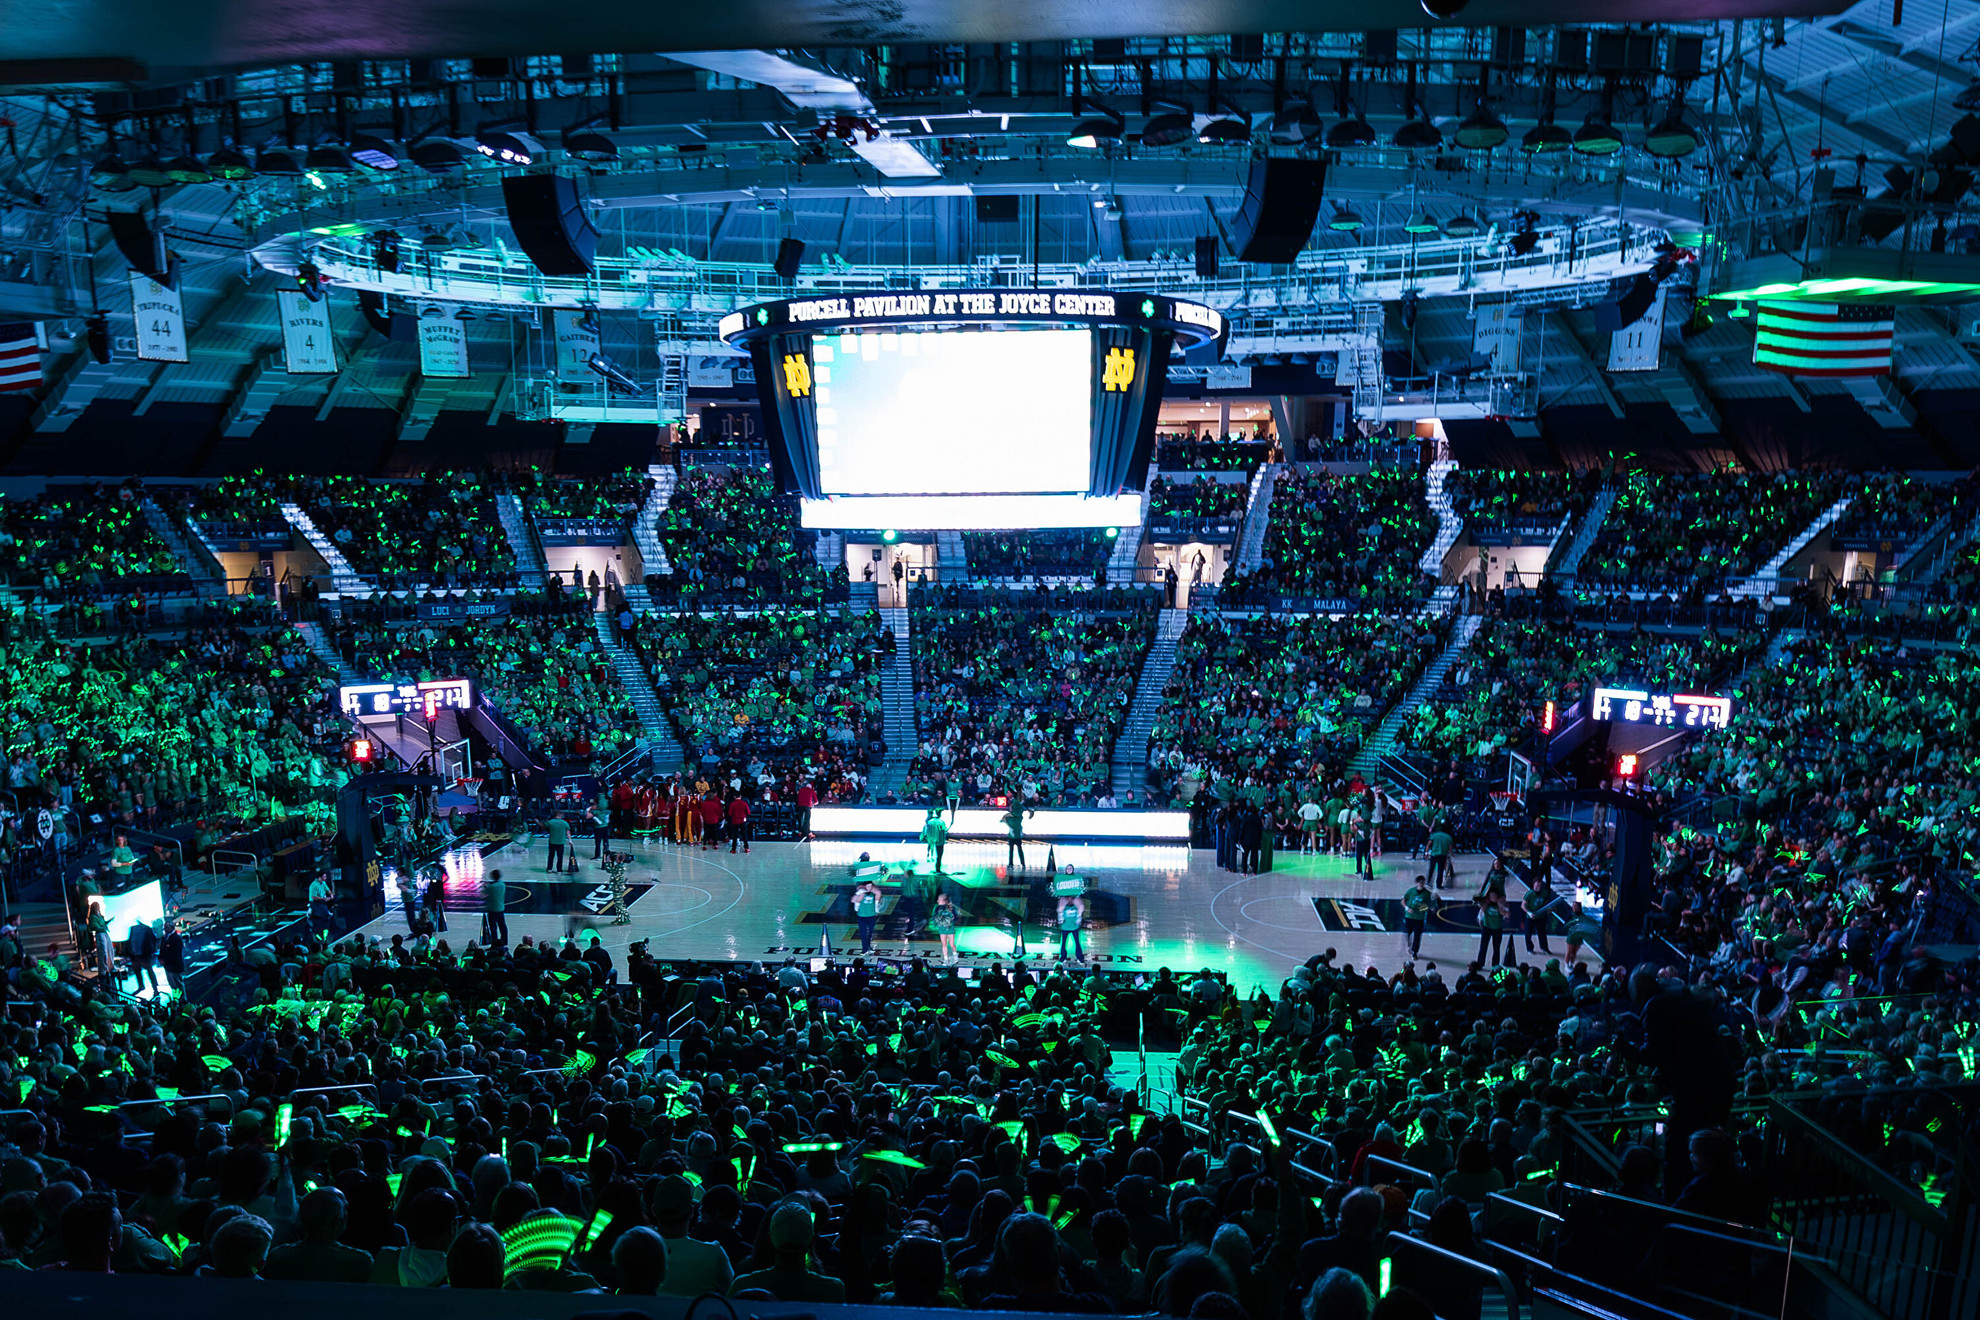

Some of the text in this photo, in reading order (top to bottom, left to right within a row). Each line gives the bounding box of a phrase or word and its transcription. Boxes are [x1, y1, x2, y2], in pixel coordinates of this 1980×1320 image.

[788, 293, 1115, 322] PURCELL PAVILION AT THE JOYCE CENTER
[152, 319, 172, 337] 44
[289, 318, 324, 328] RIVERS
[305, 335, 314, 350] 4
[559, 333, 596, 344] GAITHER
[1627, 331, 1642, 349] 11
[571, 348, 589, 364] 12
[265, 566, 272, 576] 1
[432, 605, 496, 616] LUCI JORDYN
[1282, 599, 1347, 610] KK MALAYA
[1340, 901, 1386, 931] ACC
